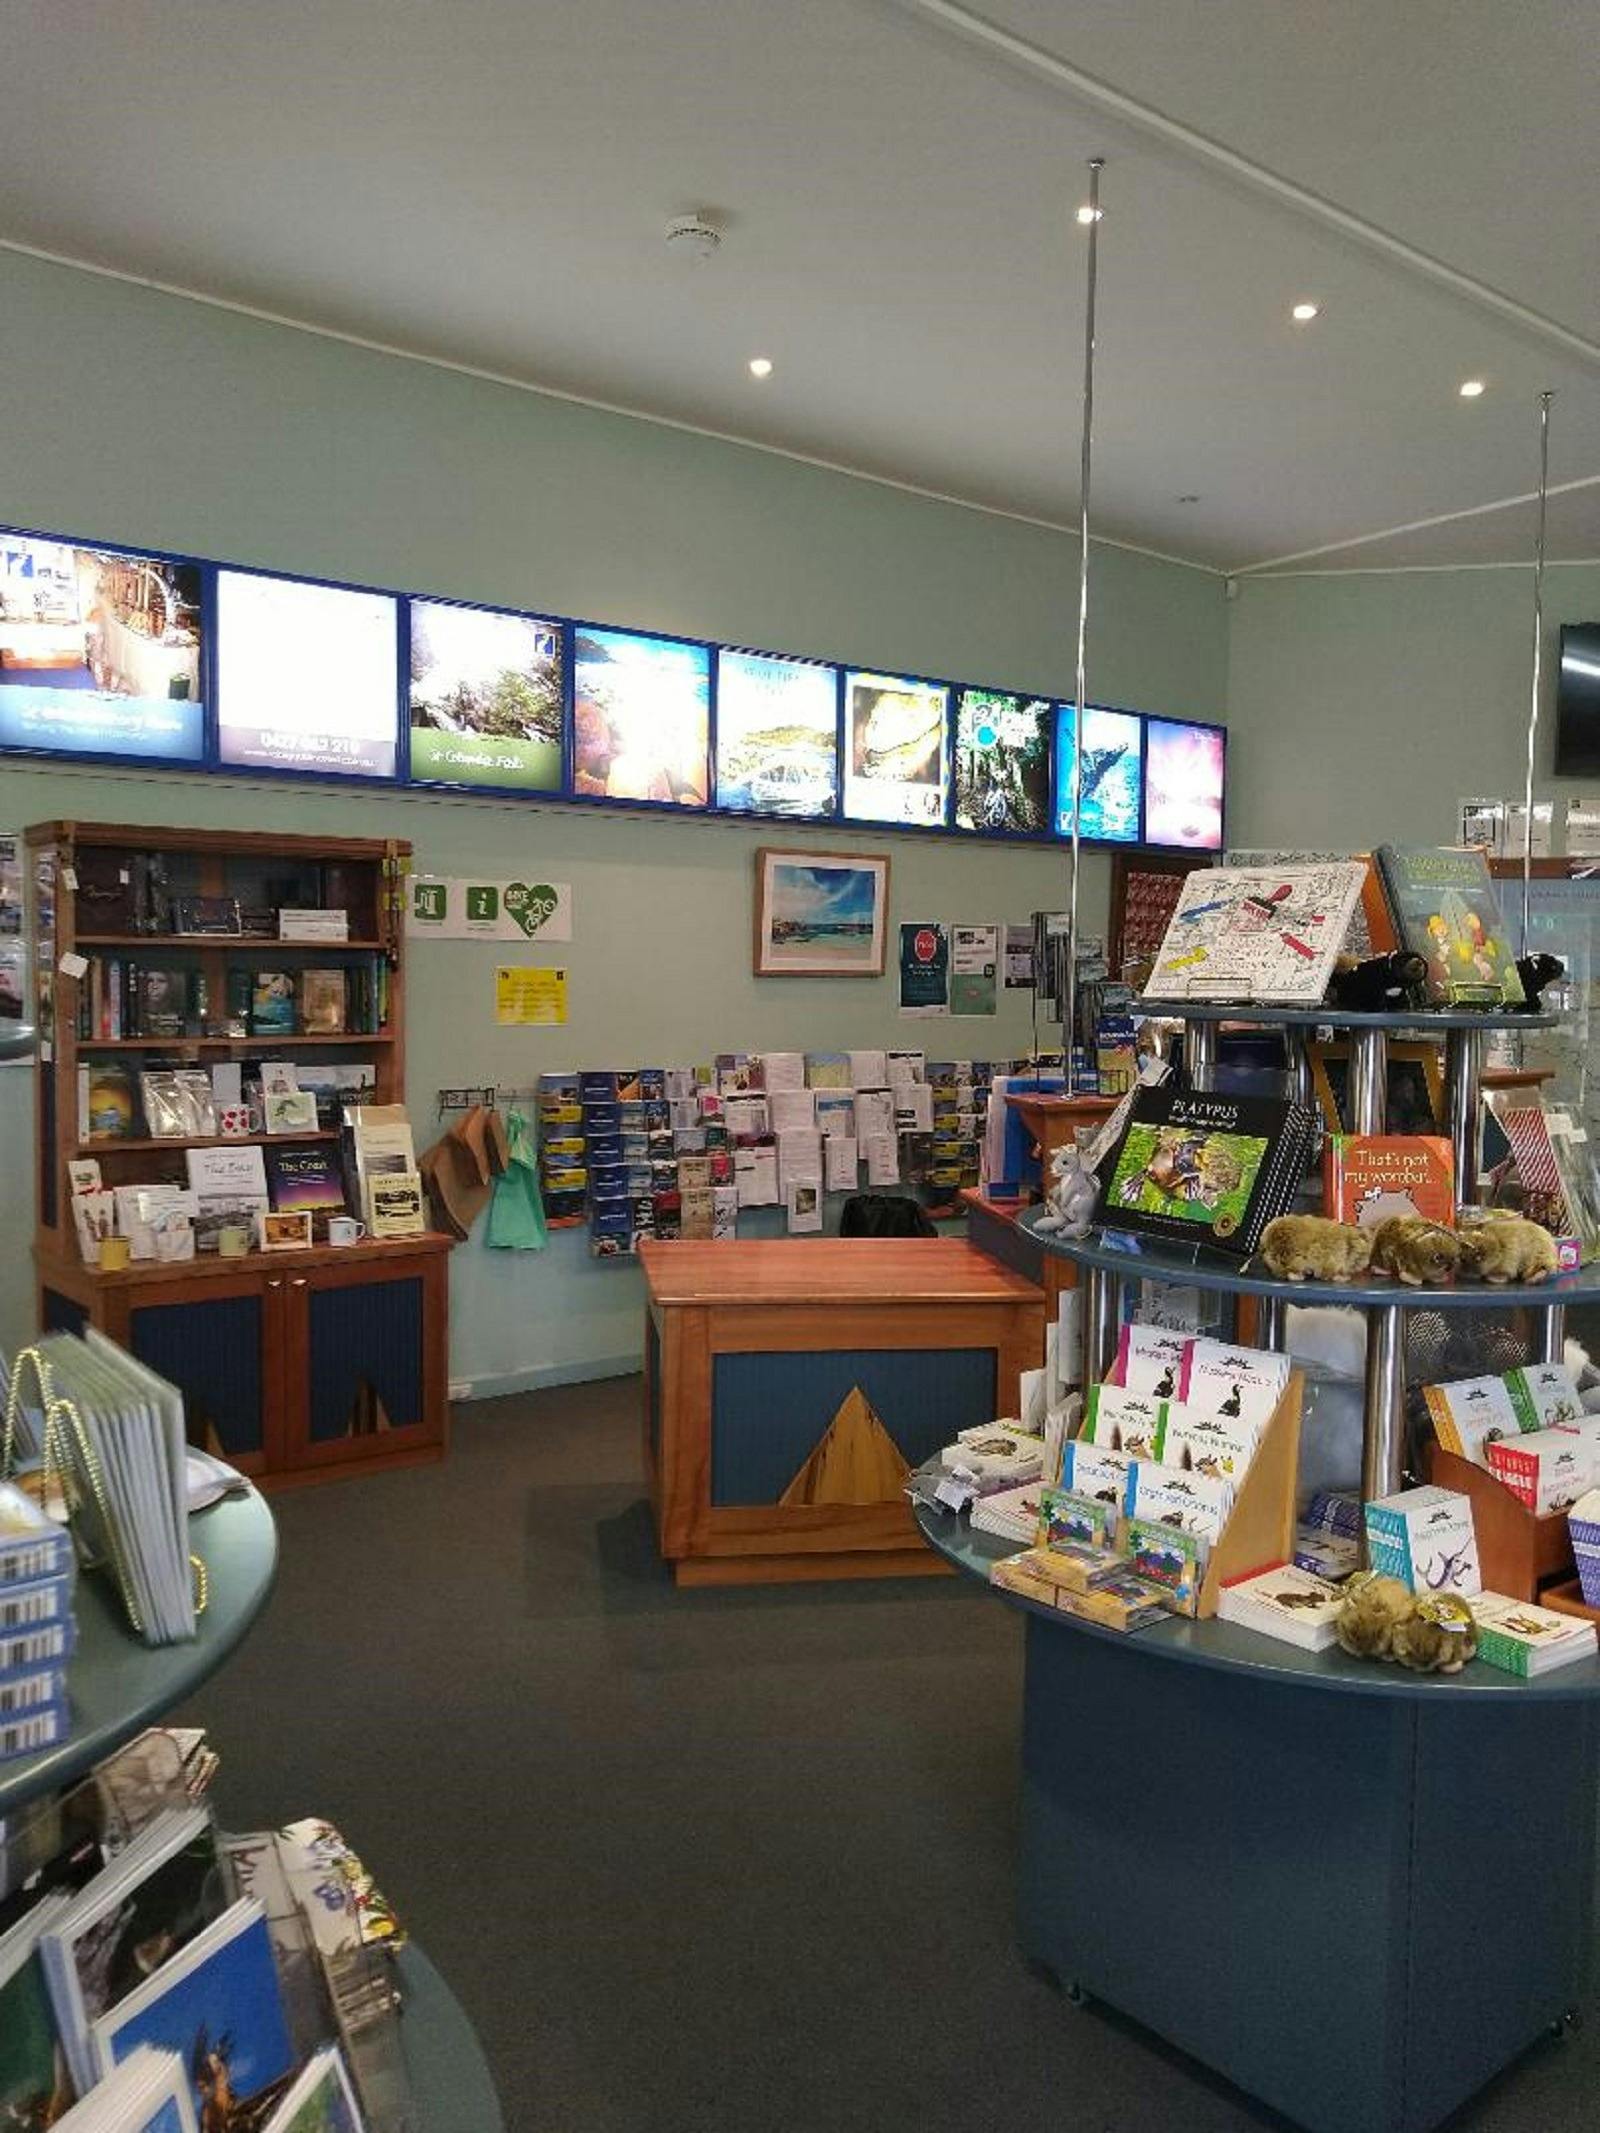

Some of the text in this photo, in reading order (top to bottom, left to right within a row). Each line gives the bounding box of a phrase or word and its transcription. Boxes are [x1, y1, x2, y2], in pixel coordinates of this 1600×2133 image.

[1172, 1099, 1239, 1119] PLATYPUS
[1356, 1150, 1430, 1167] That's not
[1344, 1171, 1369, 1188] my
